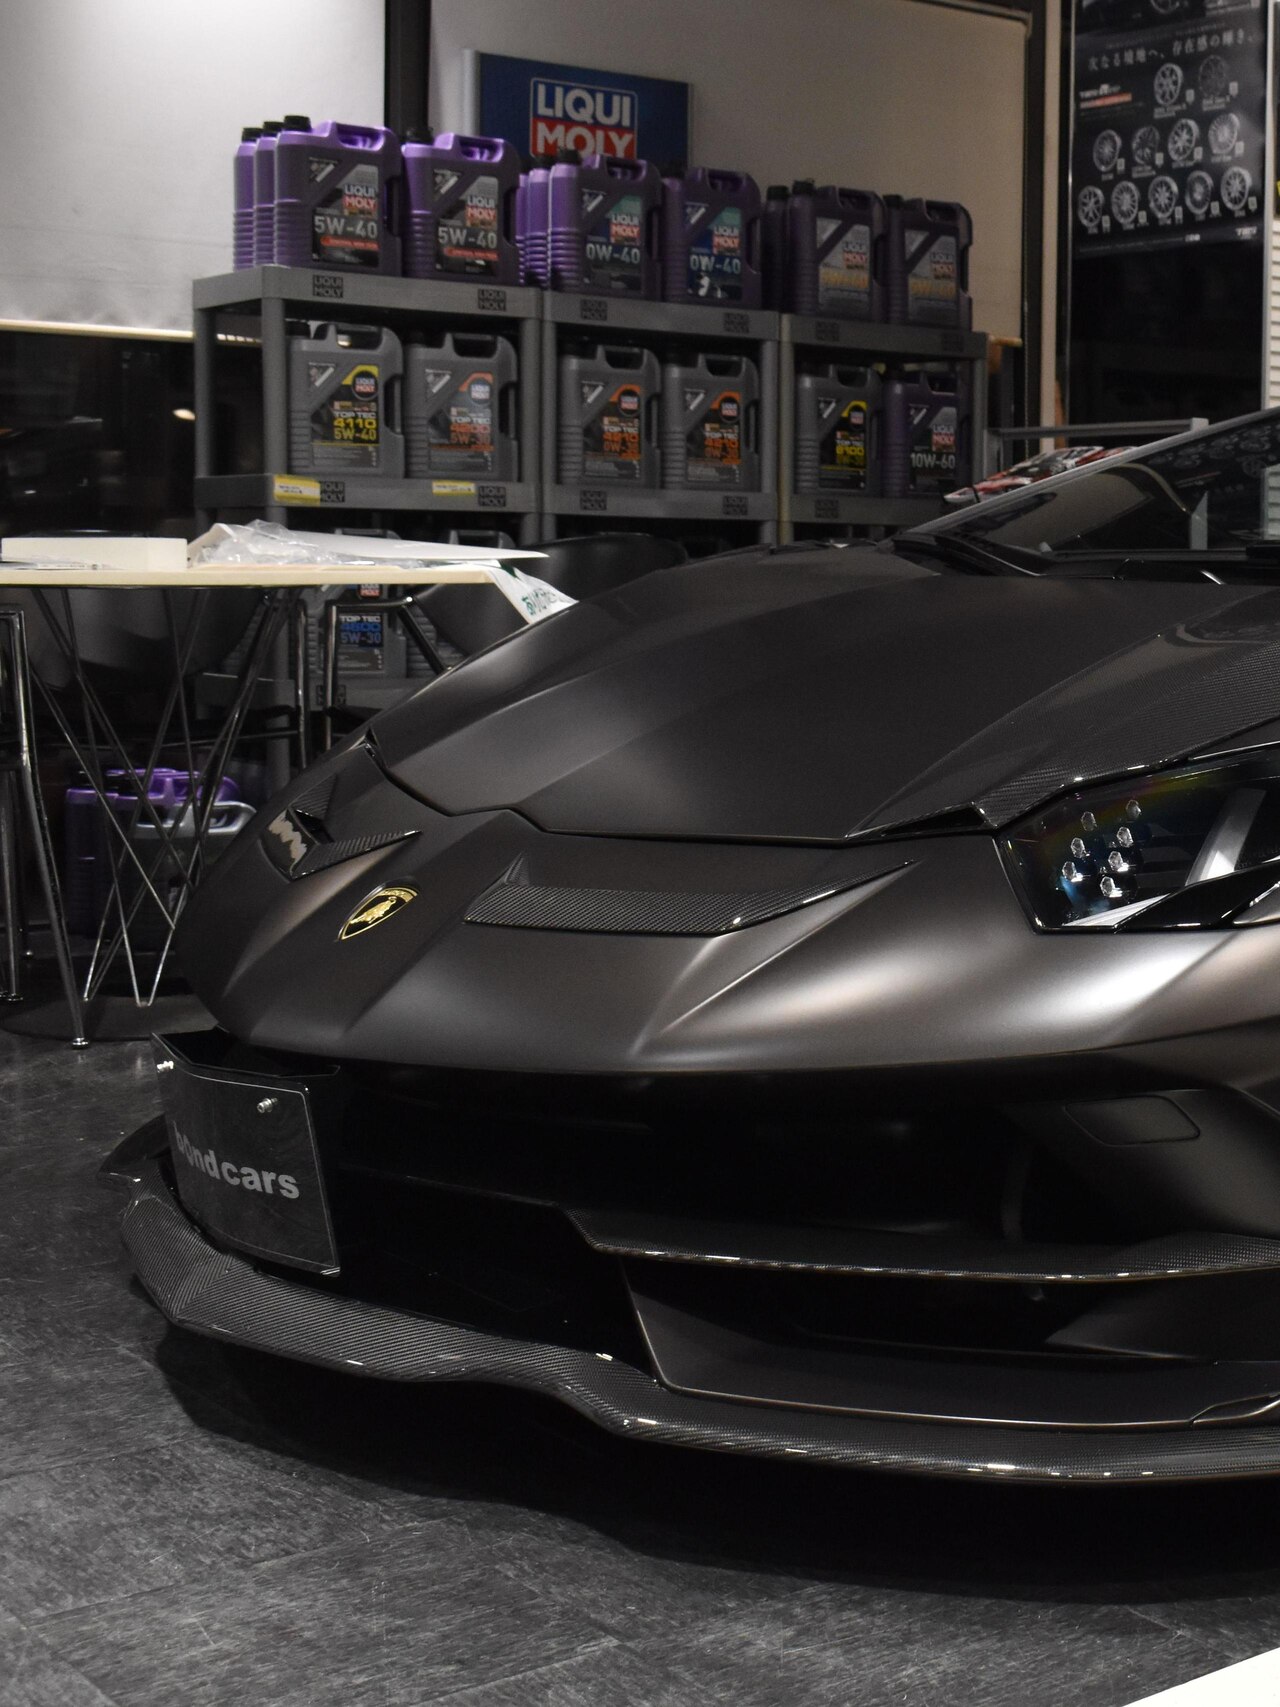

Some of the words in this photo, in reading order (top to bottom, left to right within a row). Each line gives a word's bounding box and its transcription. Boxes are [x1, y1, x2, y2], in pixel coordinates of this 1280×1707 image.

[537, 83, 631, 127] LIQUI
[537, 121, 633, 159] MOLY
[344, 184, 375, 197] LIQUI
[343, 196, 376, 208] MOLY
[466, 195, 496, 208] LIQUI
[611, 214, 640, 225] LIQUI
[314, 216, 378, 239] 5W-40
[611, 225, 640, 237] MOLY
[713, 225, 740, 236] LIQUI
[438, 227, 498, 249] 5W-40
[586, 243, 641, 264] 0W-40
[690, 254, 741, 274] 0W-40
[314, 275, 342, 286] LIQUI
[314, 285, 343, 297] MOLY
[478, 289, 505, 300] LIQUI
[333, 418, 377, 429] 4110
[334, 429, 377, 440] 5W-40
[911, 452, 955, 469] 10W-60
[340, 632, 381, 644] 5W-30
